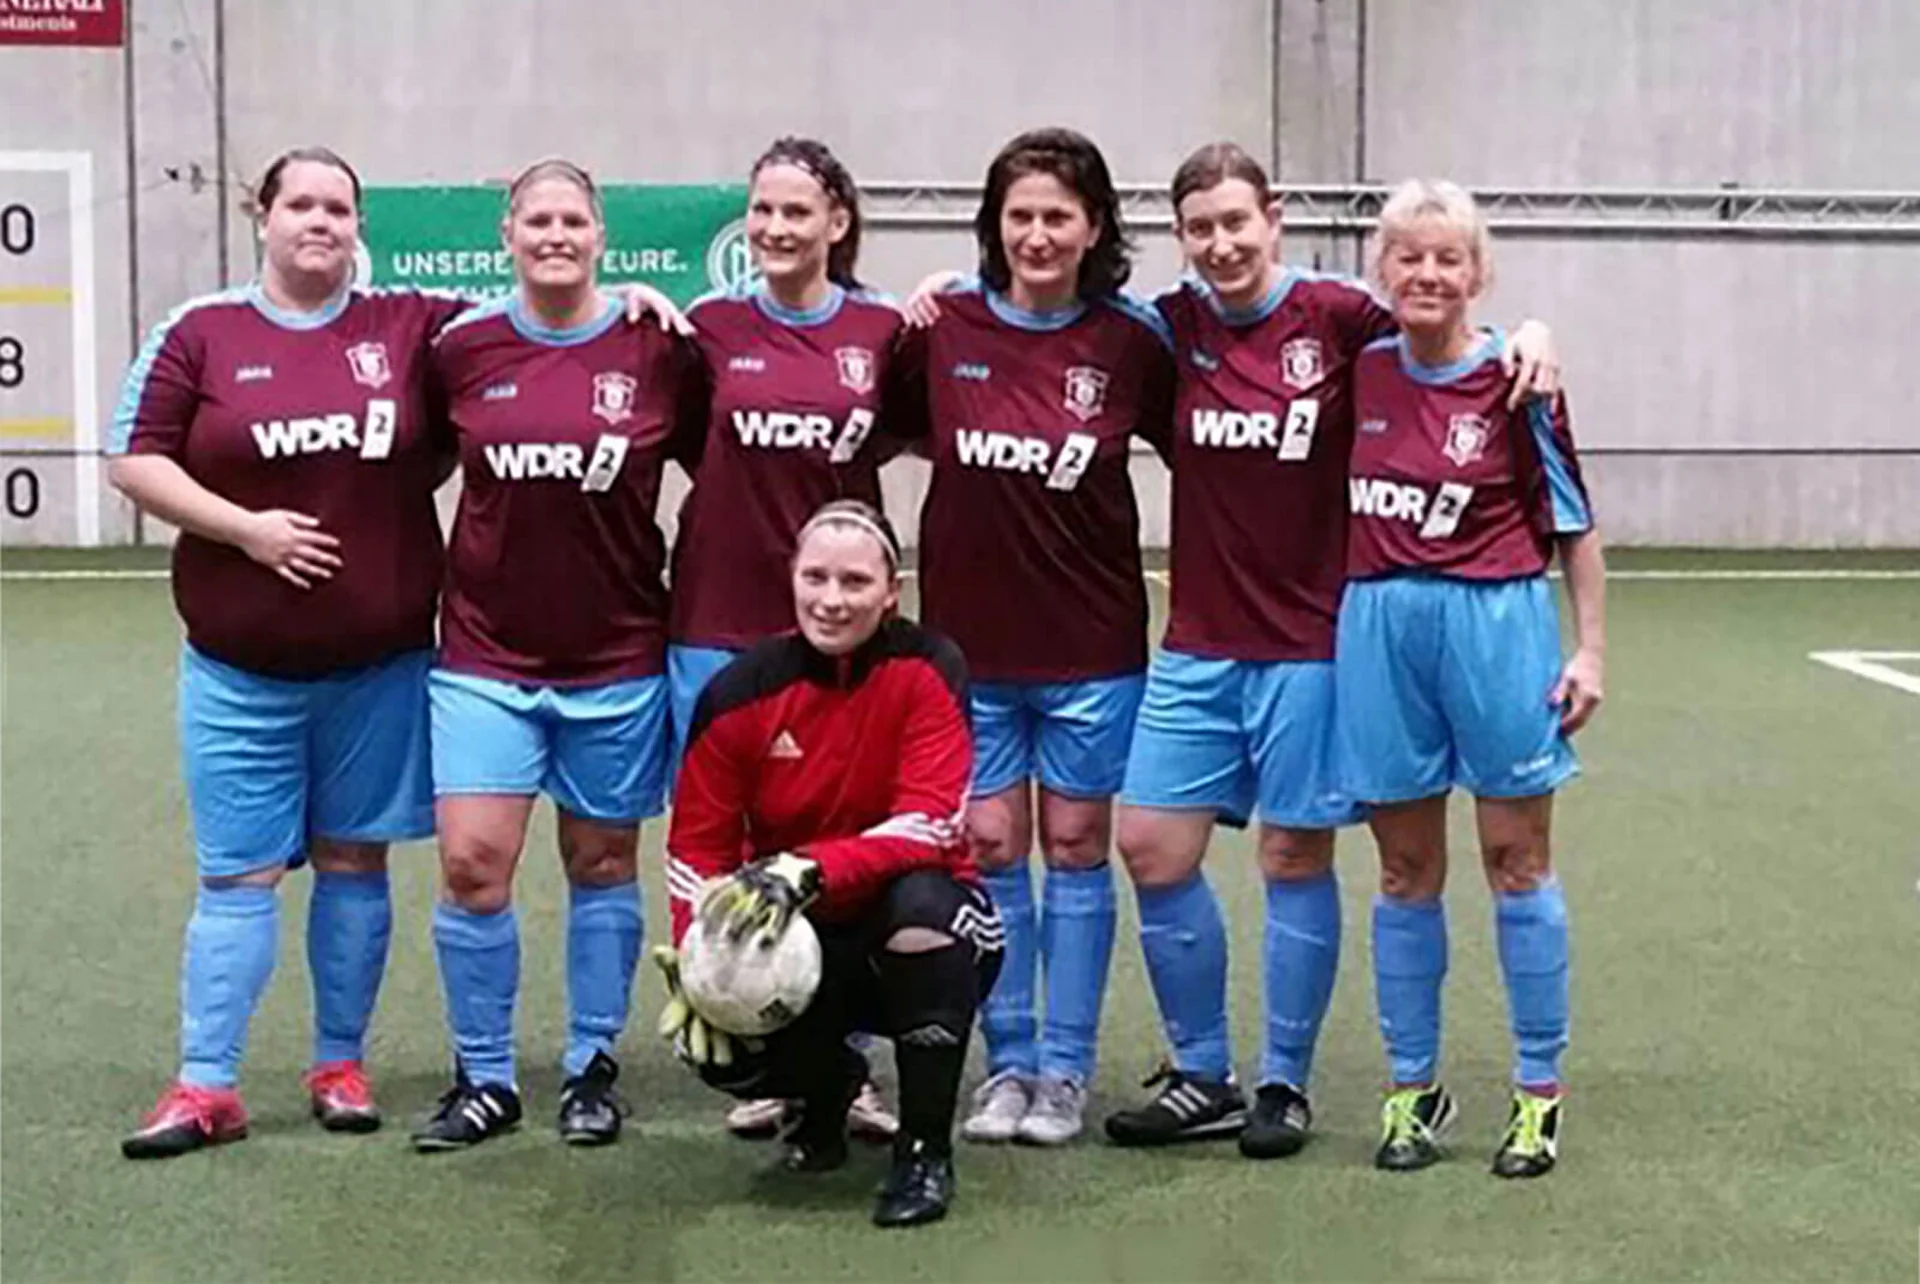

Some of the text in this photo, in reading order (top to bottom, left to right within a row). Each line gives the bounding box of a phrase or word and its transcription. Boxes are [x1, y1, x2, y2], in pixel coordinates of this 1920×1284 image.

[392, 250, 511, 277] UNSERE
[250, 412, 362, 459] WDR
[731, 409, 834, 449] WDR
[1191, 407, 1279, 449] WDR
[484, 442, 585, 480] WDR
[955, 428, 1050, 475] WDR
[1349, 477, 1428, 524] WDR
